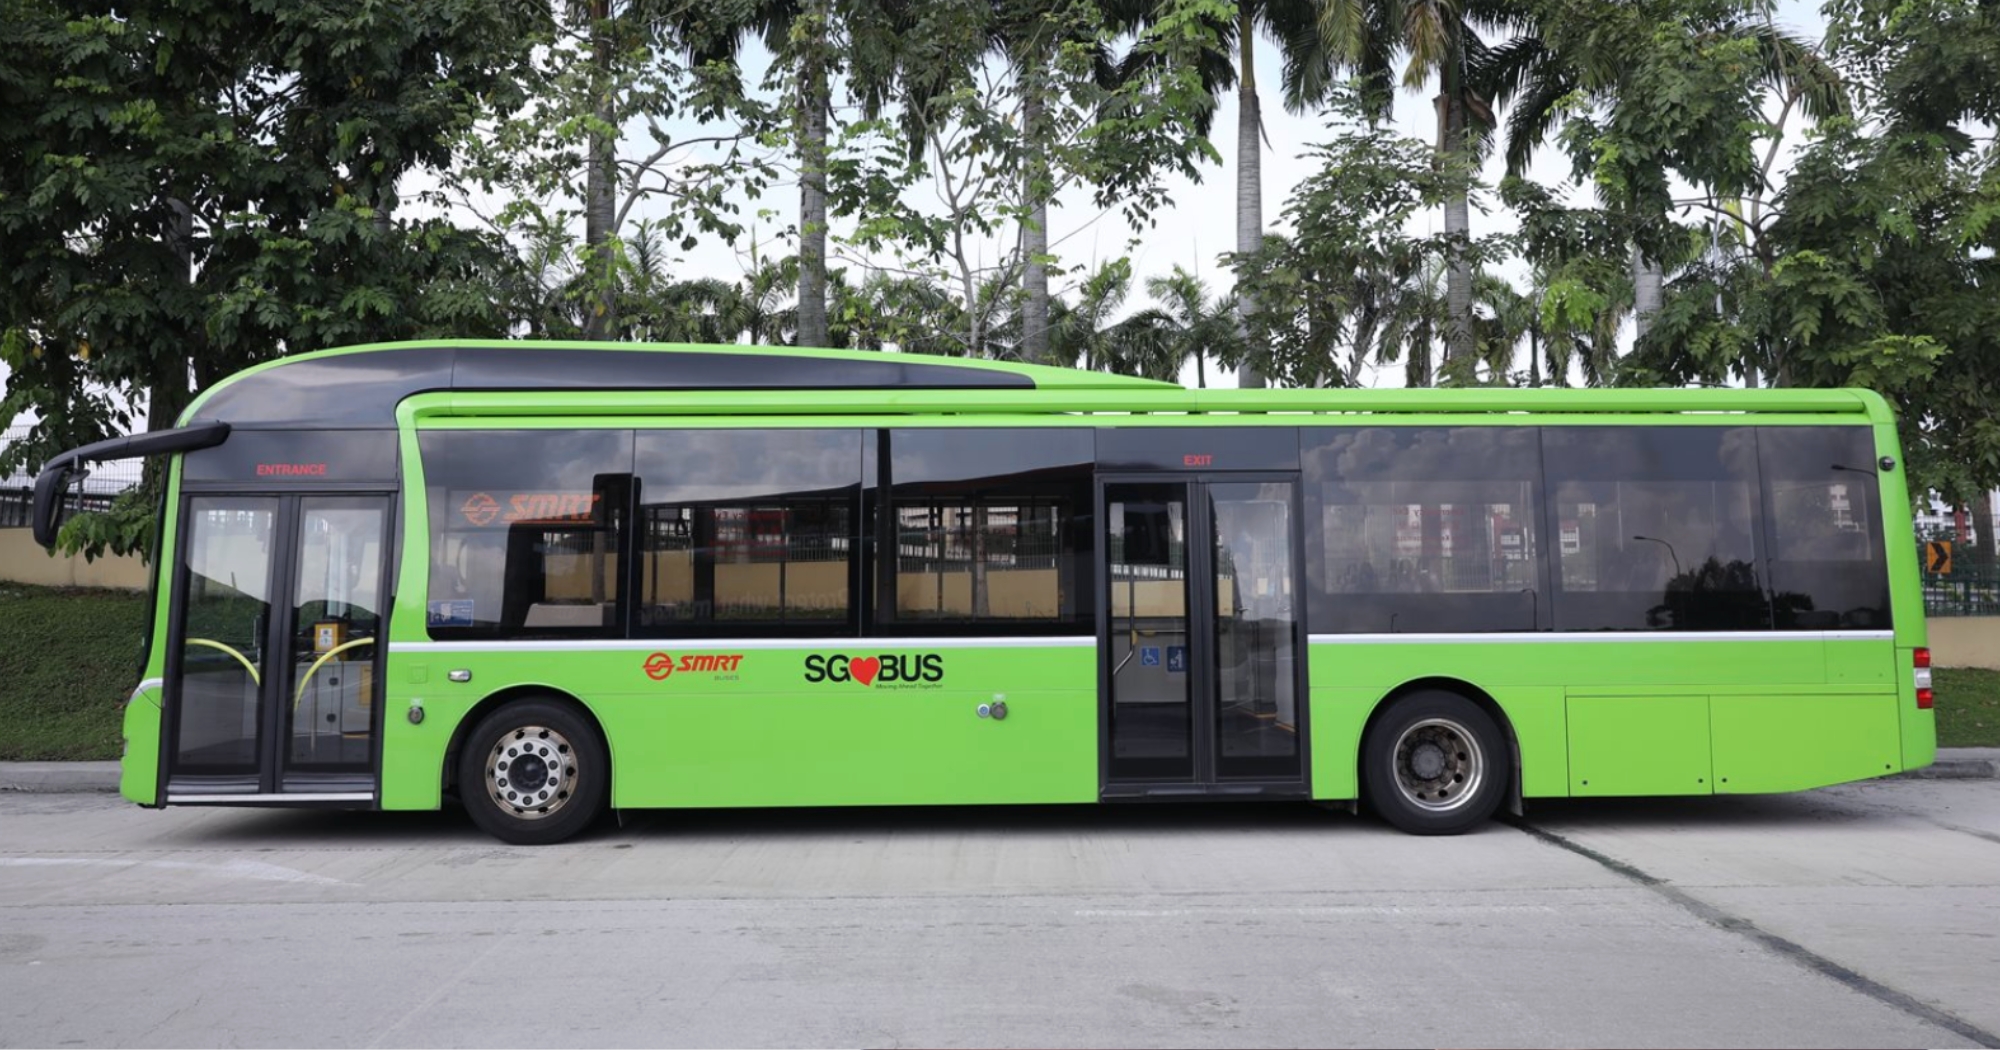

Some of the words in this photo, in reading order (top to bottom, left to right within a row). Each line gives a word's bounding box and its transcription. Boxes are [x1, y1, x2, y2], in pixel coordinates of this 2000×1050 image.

[1183, 454, 1213, 466] EXIT
[257, 463, 327, 476] ENTRANCE
[502, 494, 601, 521] SMRT
[676, 655, 744, 671] SMRT
